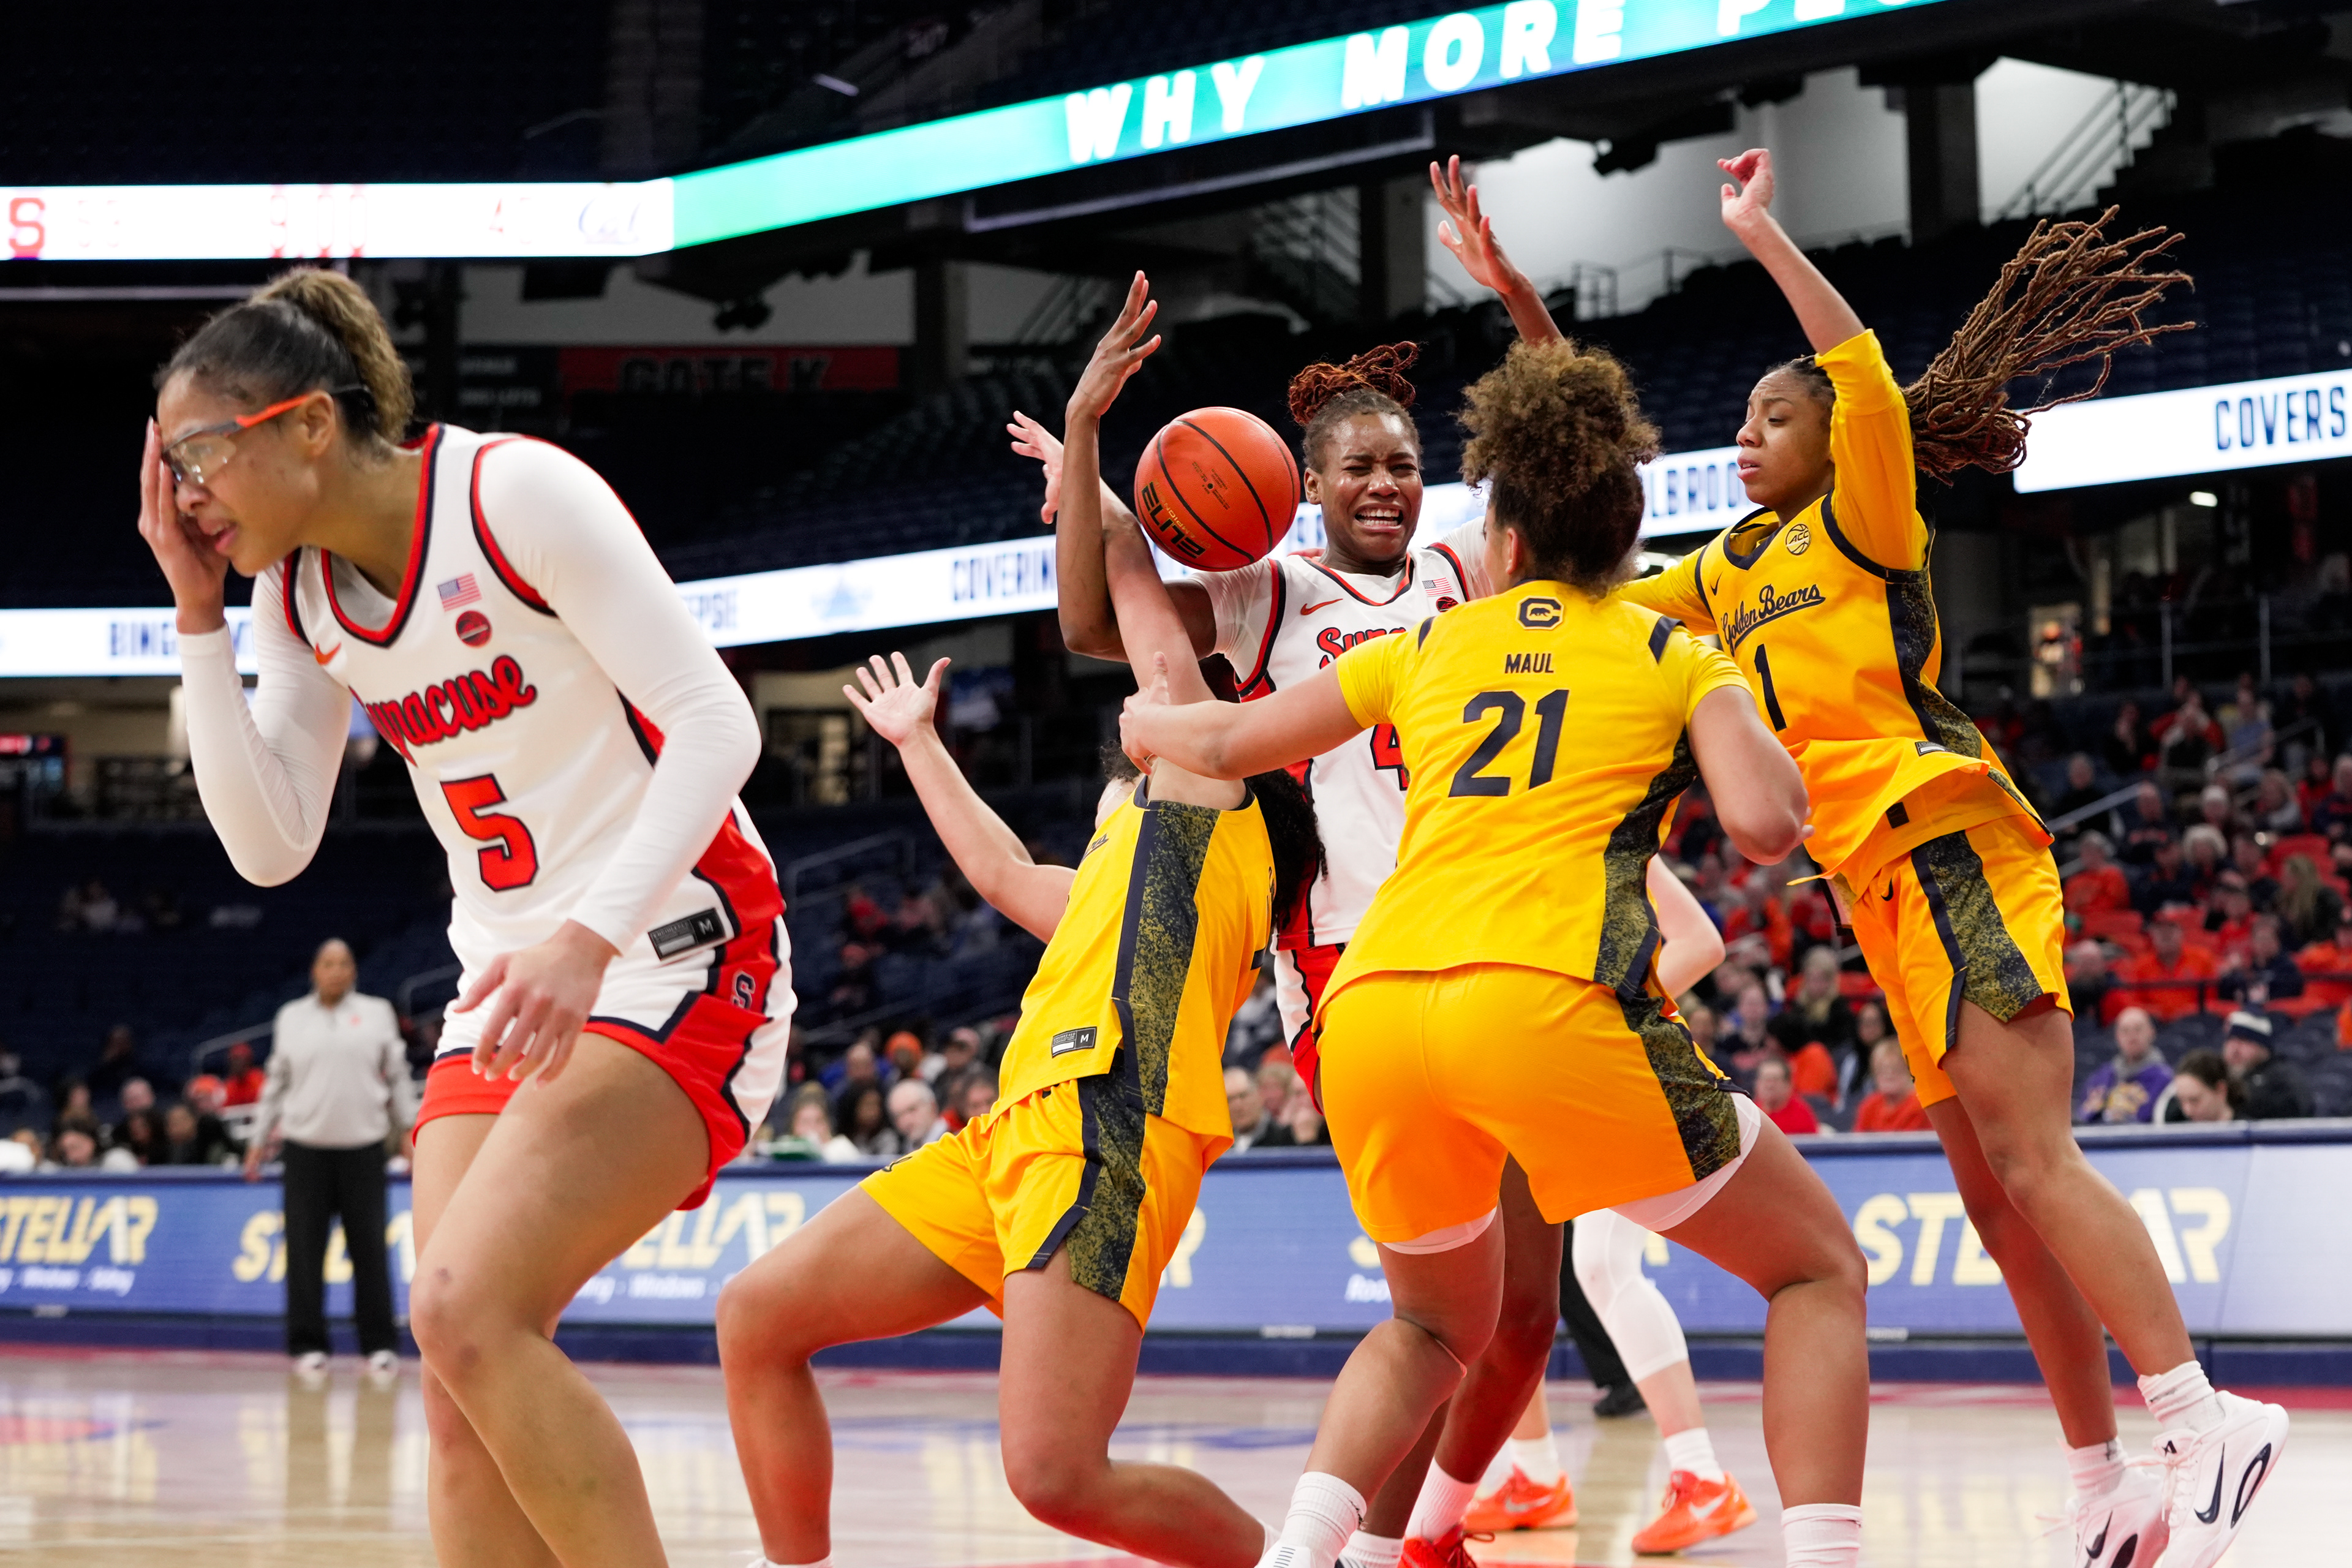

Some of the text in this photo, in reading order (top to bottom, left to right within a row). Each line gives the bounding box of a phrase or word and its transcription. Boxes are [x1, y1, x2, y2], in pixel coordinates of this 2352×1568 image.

[1065, 0, 1623, 164] WHY MORE
[9, 197, 46, 251] S
[2215, 386, 2346, 450] COVERS
[1141, 481, 1207, 559] ELITE
[1789, 530, 1809, 545] ACC
[954, 549, 1058, 601] COVERIN
[1721, 584, 1826, 658] Golden Bears
[1504, 653, 1555, 674] MAUL
[1754, 643, 1787, 732] 1
[1447, 689, 1570, 798] 21
[440, 772, 540, 894] 5
[698, 918, 714, 935] M
[731, 970, 756, 1011] S
[1080, 1033, 1090, 1044] M
[0, 1196, 159, 1265] TELLAR
